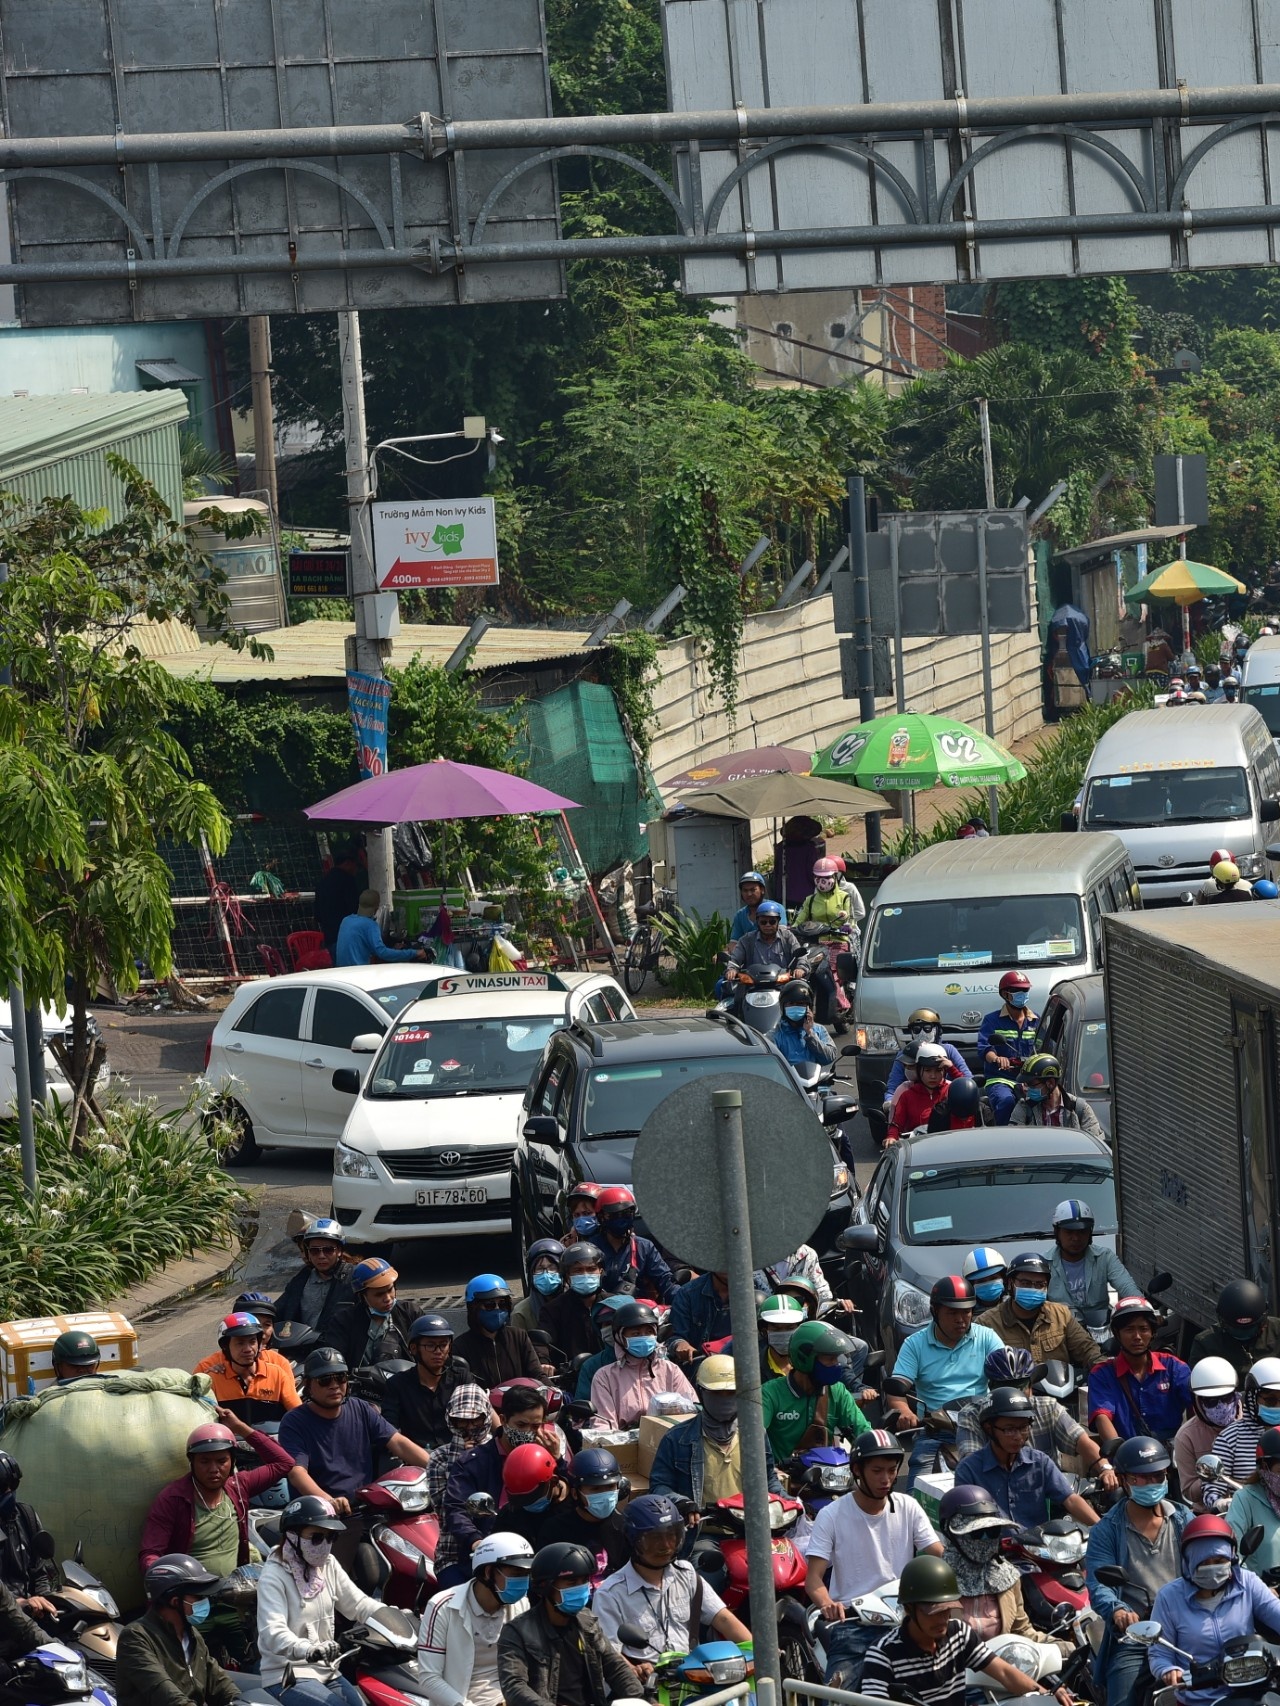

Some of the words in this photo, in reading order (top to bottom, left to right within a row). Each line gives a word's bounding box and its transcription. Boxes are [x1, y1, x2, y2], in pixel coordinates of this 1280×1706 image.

[379, 510, 410, 519] Trường
[436, 508, 453, 516] Non
[468, 505, 486, 515] Kids
[404, 528, 431, 548] ivy
[438, 531, 459, 542] kids
[392, 574, 421, 584] 400m
[831, 734, 868, 765] C2
[940, 734, 983, 762] C2
[466, 977, 521, 989] VINASUN
[521, 976, 546, 987] TAXI
[394, 1032, 430, 1041] 10144.A
[776, 1410, 800, 1420] Grab
